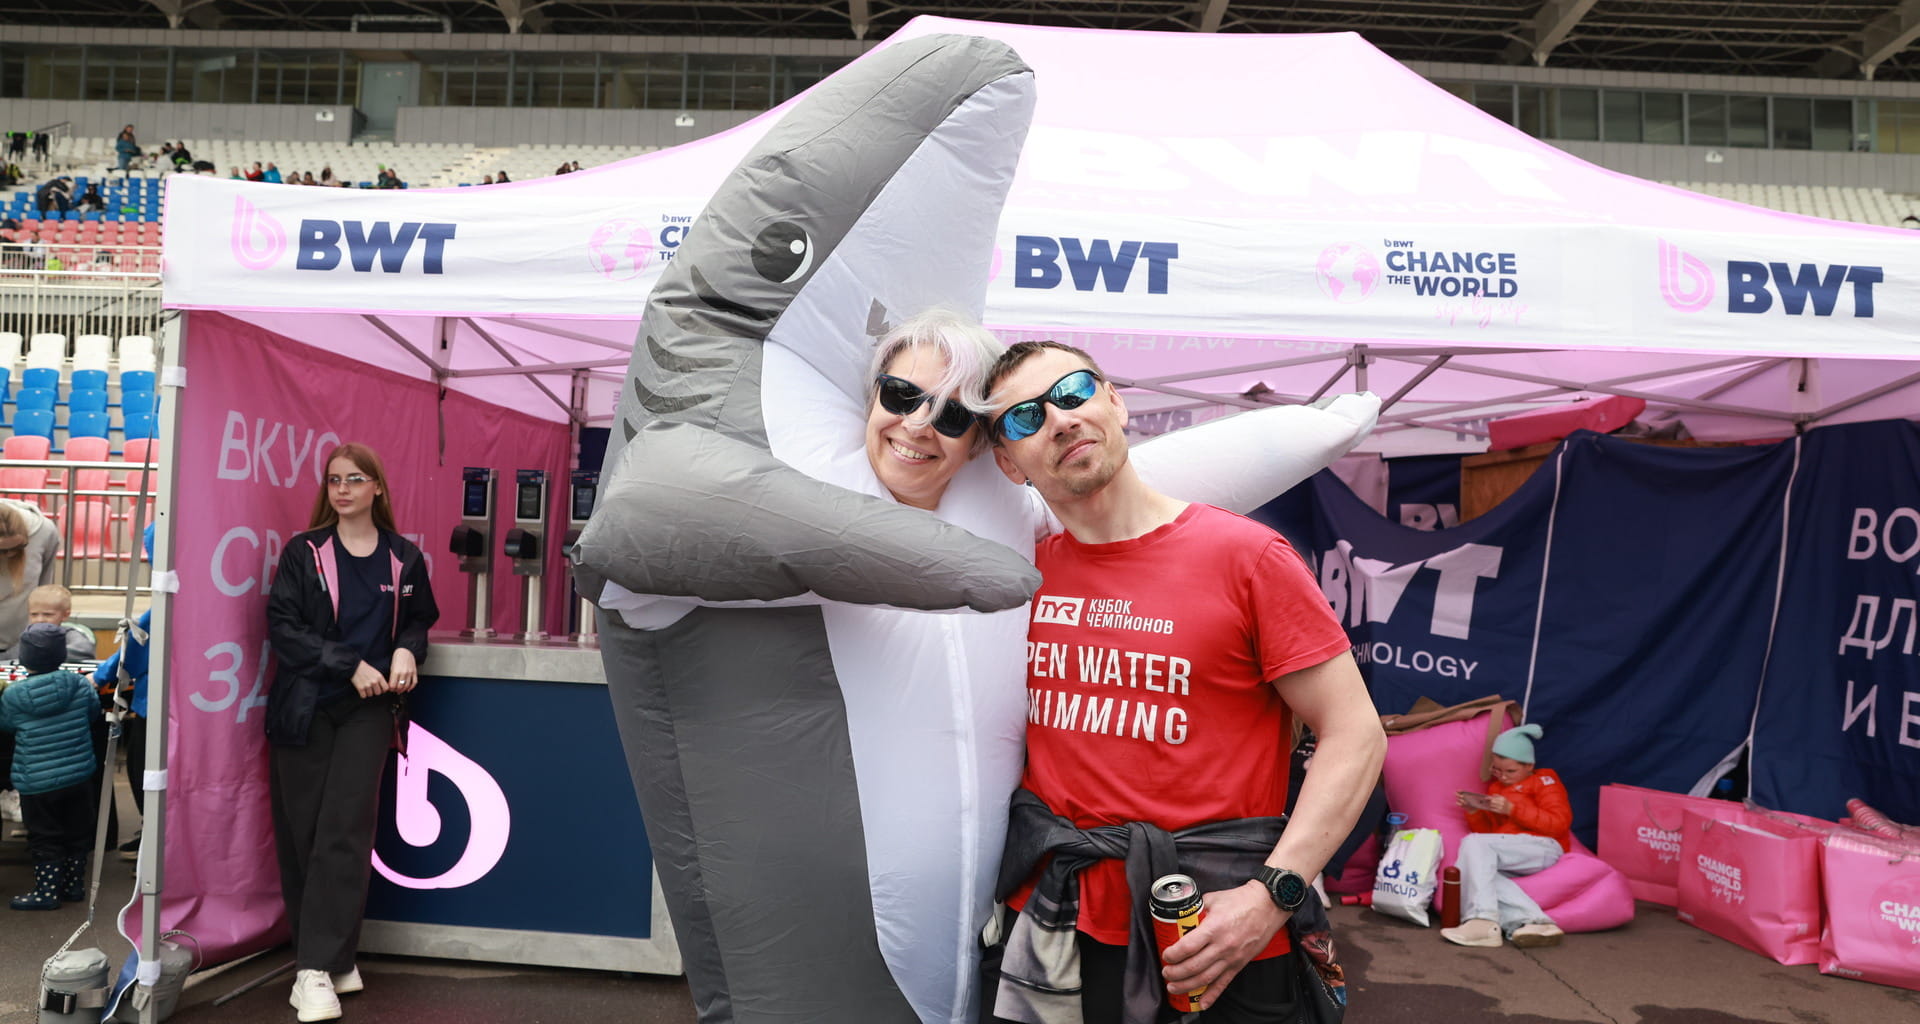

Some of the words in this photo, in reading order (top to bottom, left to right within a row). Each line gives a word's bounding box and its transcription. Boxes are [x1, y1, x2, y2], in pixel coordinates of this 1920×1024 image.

[296, 219, 457, 274] BWT
[659, 251, 675, 260] TH
[1015, 235, 1178, 294] BWT
[1386, 250, 1517, 275] CHANGE
[1387, 275, 1410, 285] THE
[1414, 276, 1518, 298] WORLD
[1728, 260, 1883, 318] BWT
[1848, 507, 1920, 575] ВО
[1086, 612, 1174, 634] ЧЕМПИОНОВ
[1089, 599, 1133, 615] КУБОК
[1838, 594, 1920, 660] ДЛ
[1027, 641, 1068, 679] PEN
[1077, 645, 1191, 696] WATER
[1027, 688, 1188, 745] WIMMING
[1697, 853, 1741, 880] CHANGE
[1706, 871, 1742, 891] WORLD
